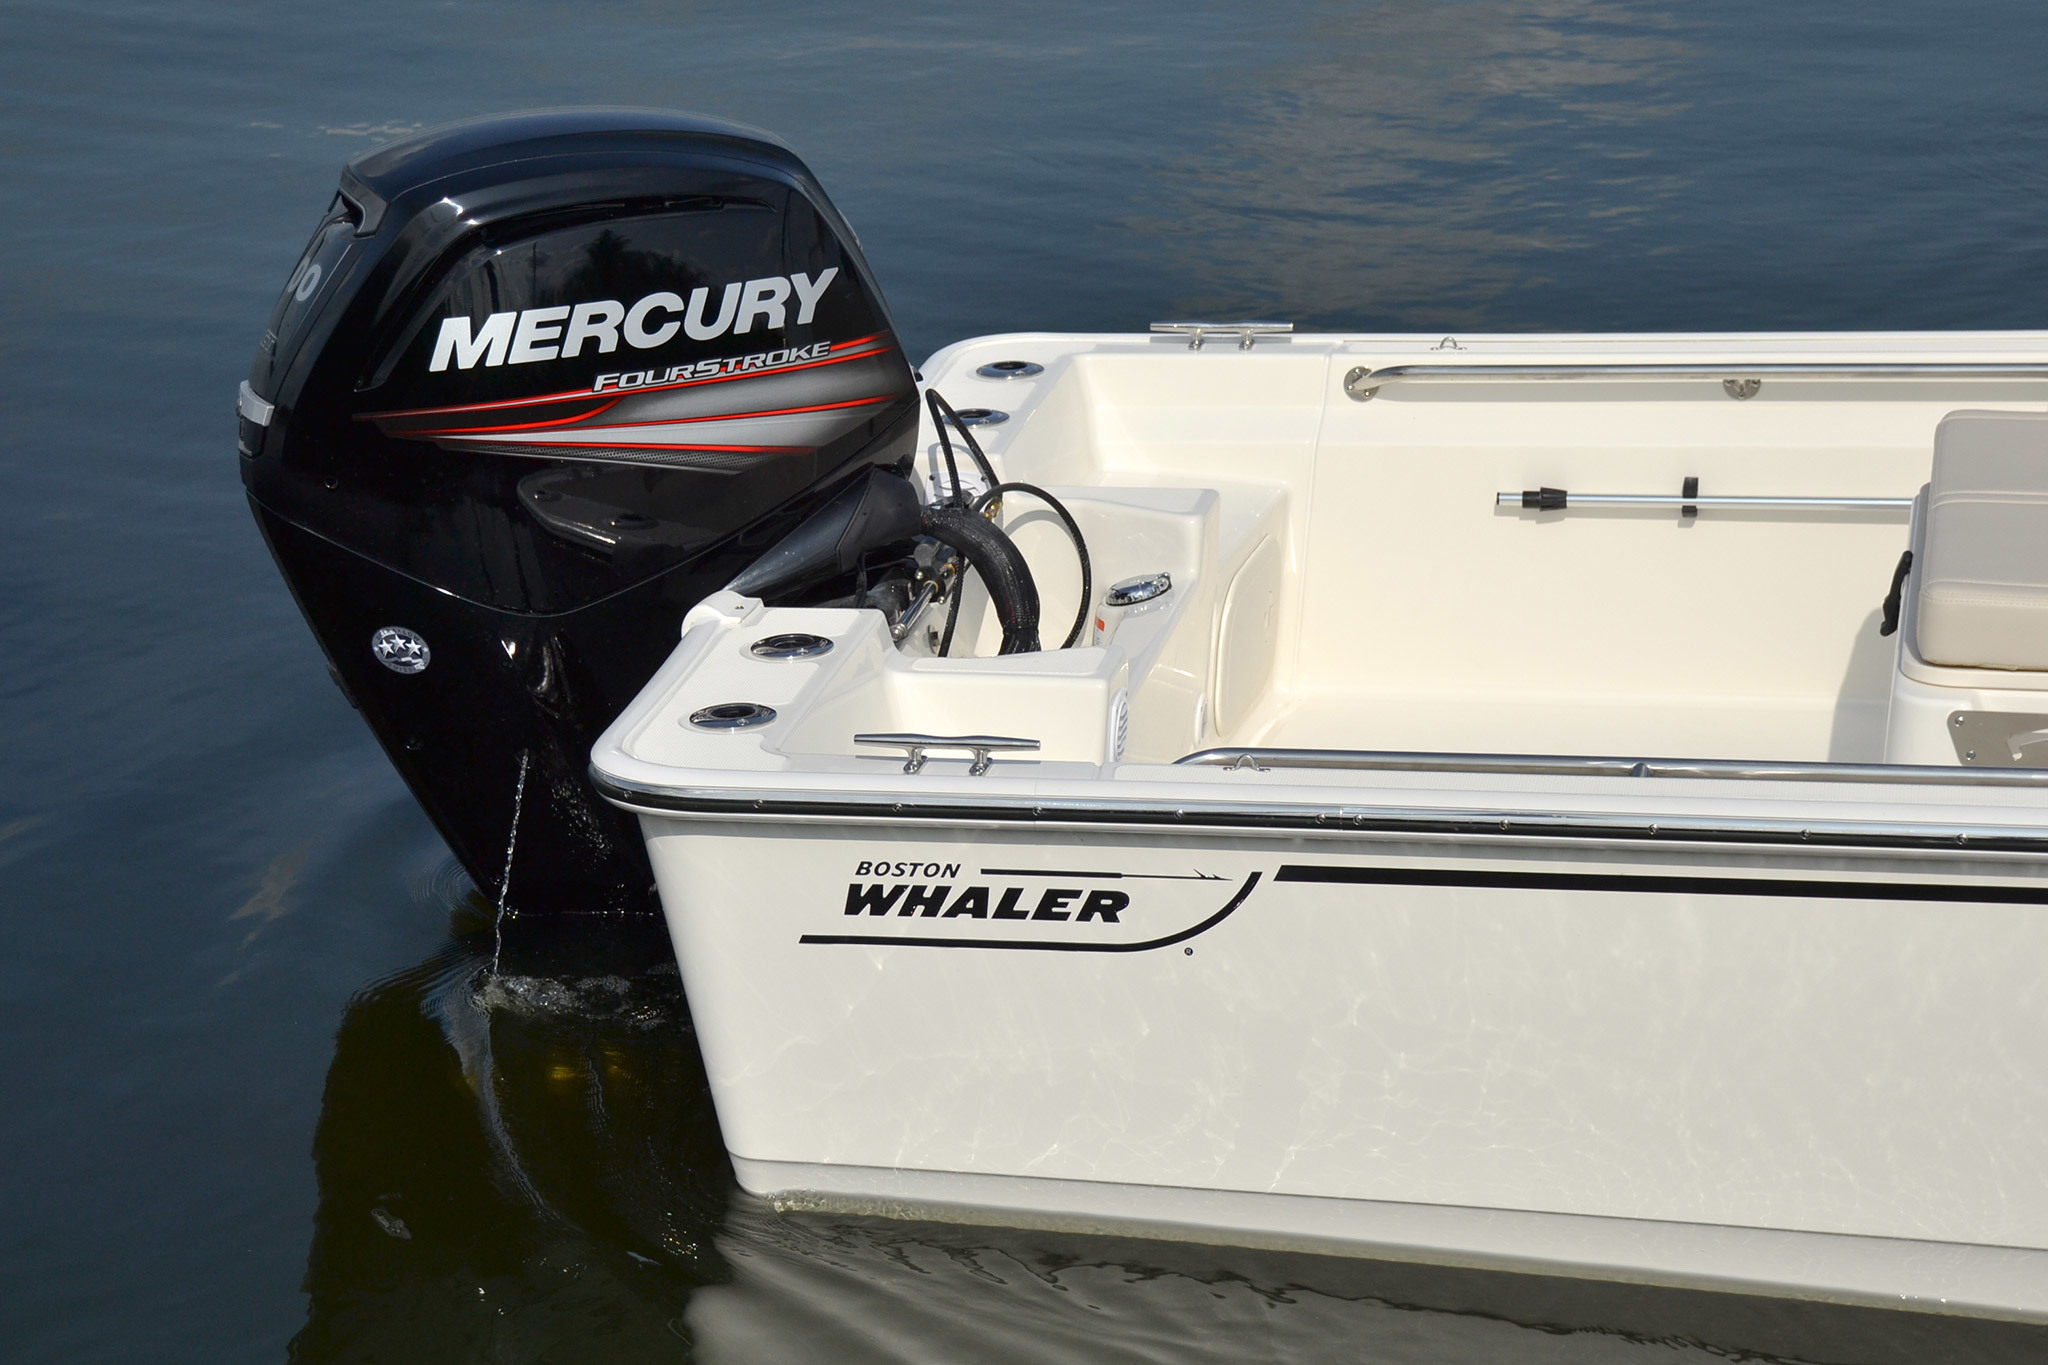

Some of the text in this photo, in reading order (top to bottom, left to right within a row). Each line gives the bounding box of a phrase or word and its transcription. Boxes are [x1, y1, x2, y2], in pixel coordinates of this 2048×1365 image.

[428, 266, 839, 373] MERCURY
[593, 341, 831, 392] FOURSTROKE
[402, 630, 421, 642] LOW
[854, 860, 962, 879] BOSTON
[844, 883, 1131, 923] WHALER
